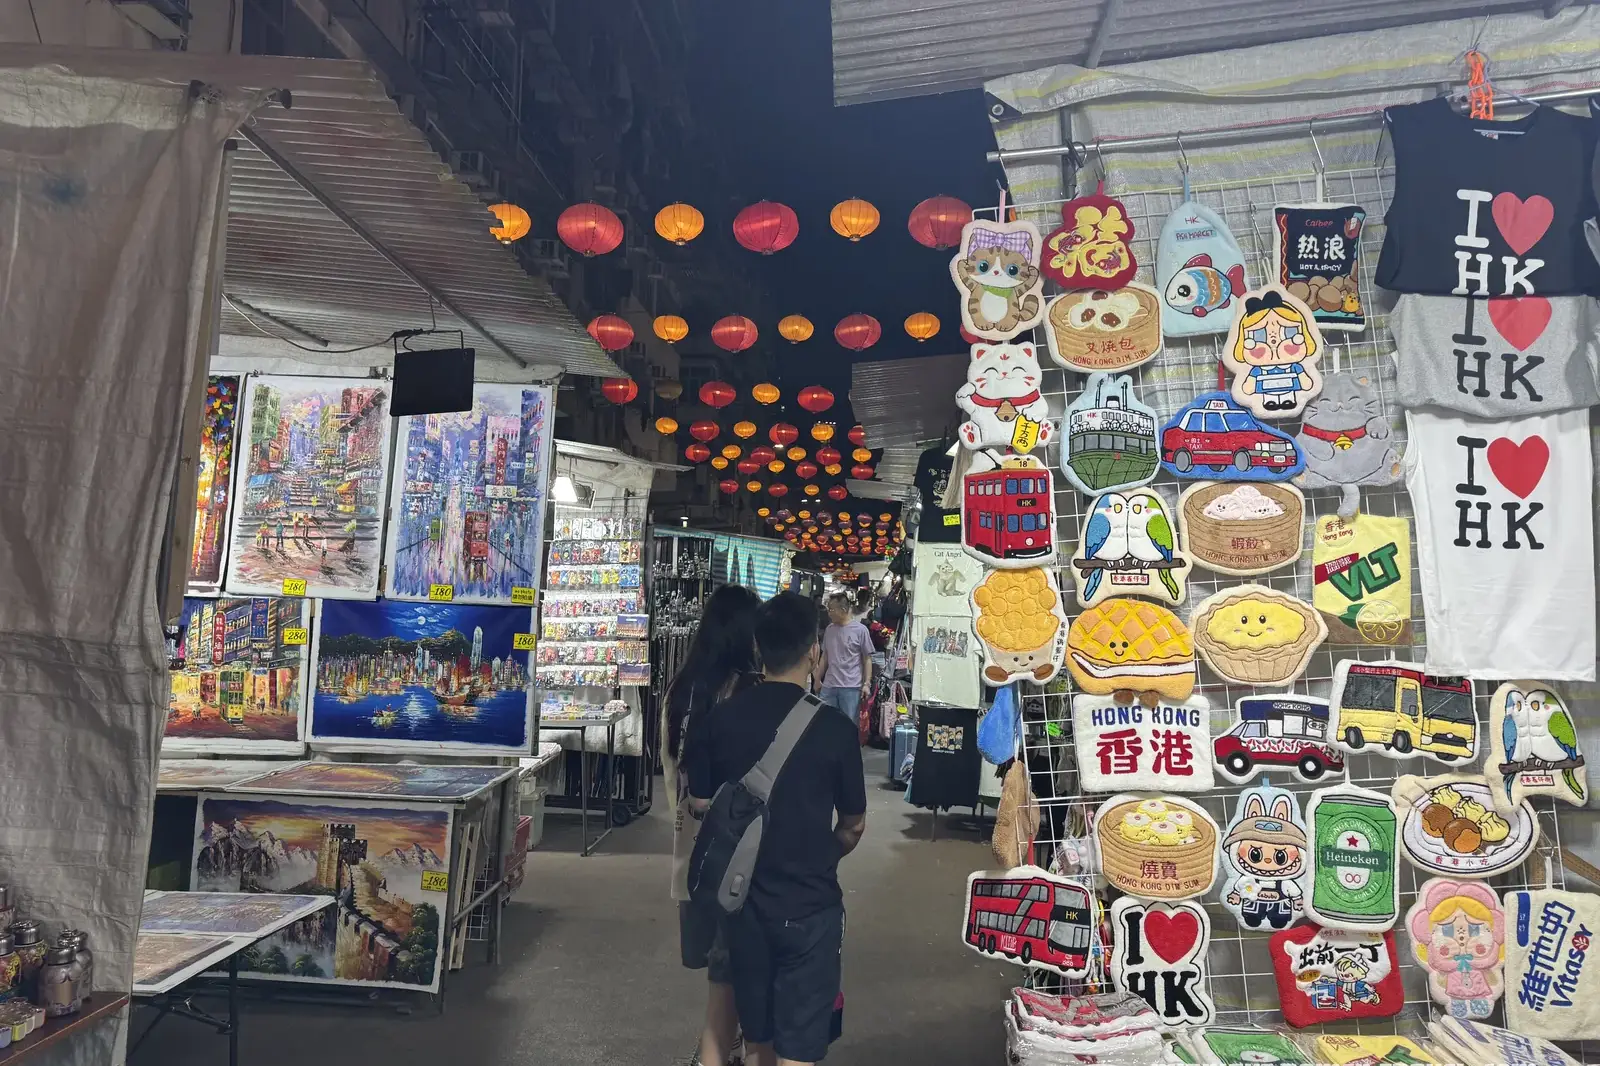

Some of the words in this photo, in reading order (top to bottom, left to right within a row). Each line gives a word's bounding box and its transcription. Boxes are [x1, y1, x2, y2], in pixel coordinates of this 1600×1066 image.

[1185, 216, 1200, 224] HK
[1454, 189, 1493, 248] I
[1297, 233, 1346, 260] 热浪
[1451, 250, 1545, 296] HK
[1073, 356, 1091, 365] HONG
[1094, 357, 1113, 366] KONG
[1116, 354, 1131, 363] DIM
[1135, 349, 1149, 359] SUM
[1452, 349, 1545, 402] HK
[1019, 460, 1028, 468] 18
[1455, 435, 1488, 496] I
[1453, 499, 1545, 550] HK
[1205, 551, 1224, 561] HONG
[1328, 541, 1401, 602] VLT
[288, 582, 304, 591] 180
[434, 588, 452, 596] 180
[287, 631, 306, 640] 280
[517, 636, 534, 646] 180
[1091, 705, 1142, 726] HONG
[1151, 705, 1200, 727] KONG
[1096, 728, 1194, 776] 香港
[1326, 852, 1380, 865] Heineken
[1140, 859, 1179, 881] 燒賣
[428, 876, 447, 887] 180
[1116, 874, 1137, 888] HONG
[1140, 880, 1161, 890] KONG
[1164, 882, 1181, 890] DIM
[1183, 879, 1200, 889] SUM
[1065, 910, 1079, 920] HK
[1124, 911, 1145, 966] I
[1299, 941, 1383, 969] 出前一丁
[1127, 970, 1204, 1018] HK
